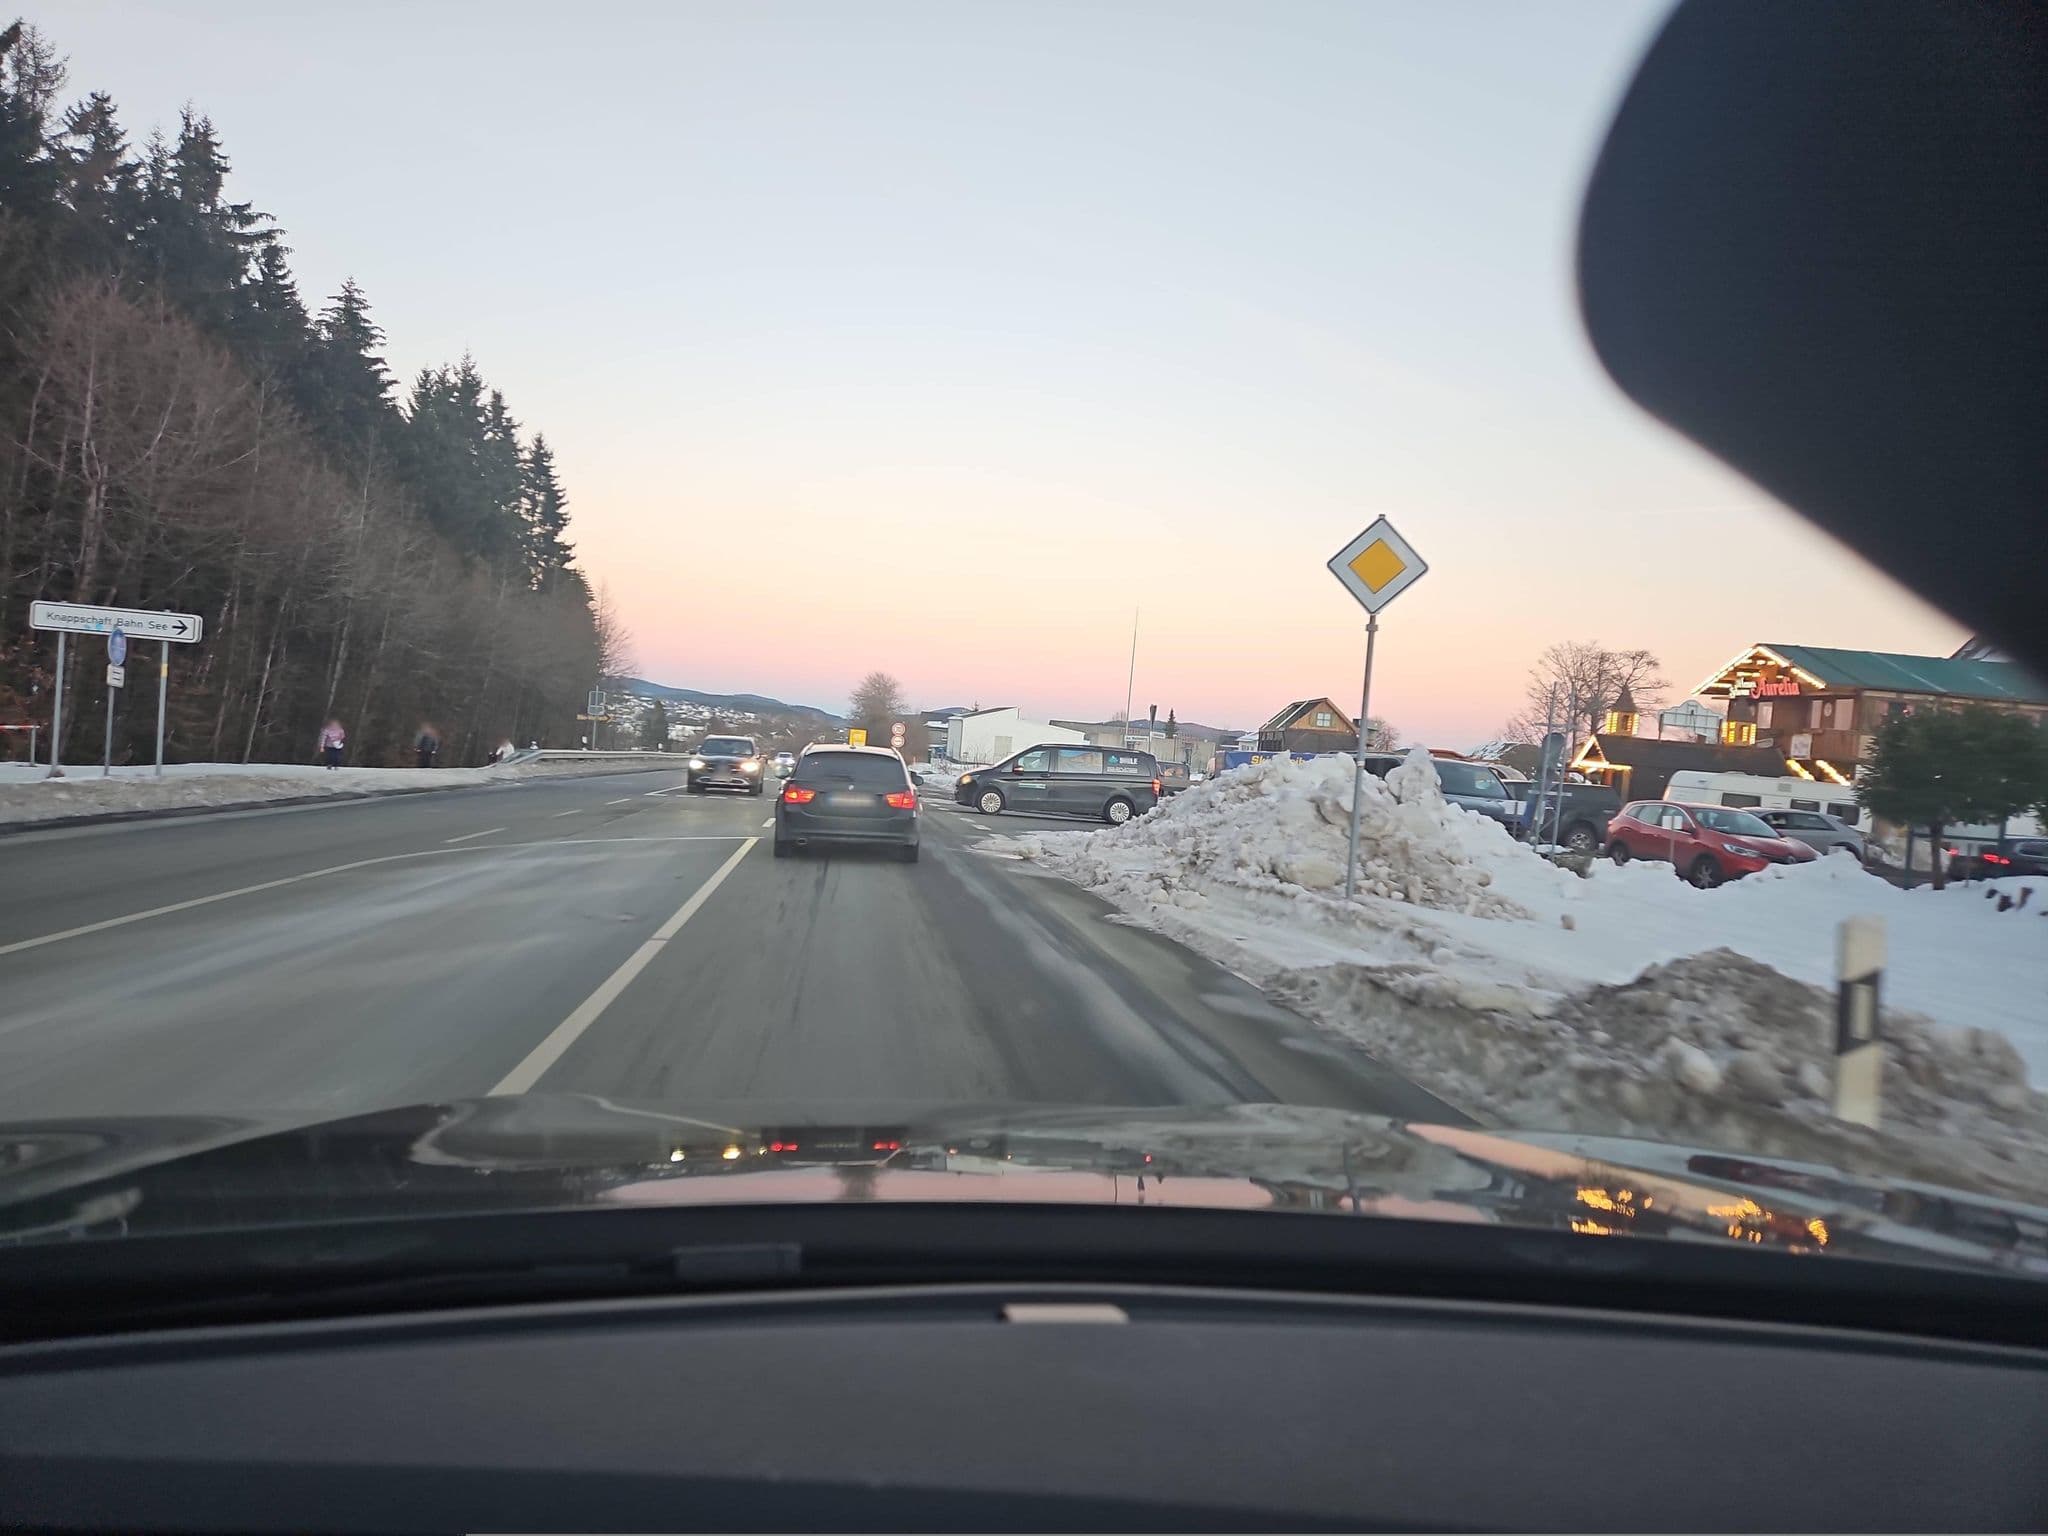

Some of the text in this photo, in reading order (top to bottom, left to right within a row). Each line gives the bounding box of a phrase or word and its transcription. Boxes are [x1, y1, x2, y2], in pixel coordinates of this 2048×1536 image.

[46, 611, 168, 631] Knappschaft Bahn See
[1751, 676, 1800, 699] Aurelia
